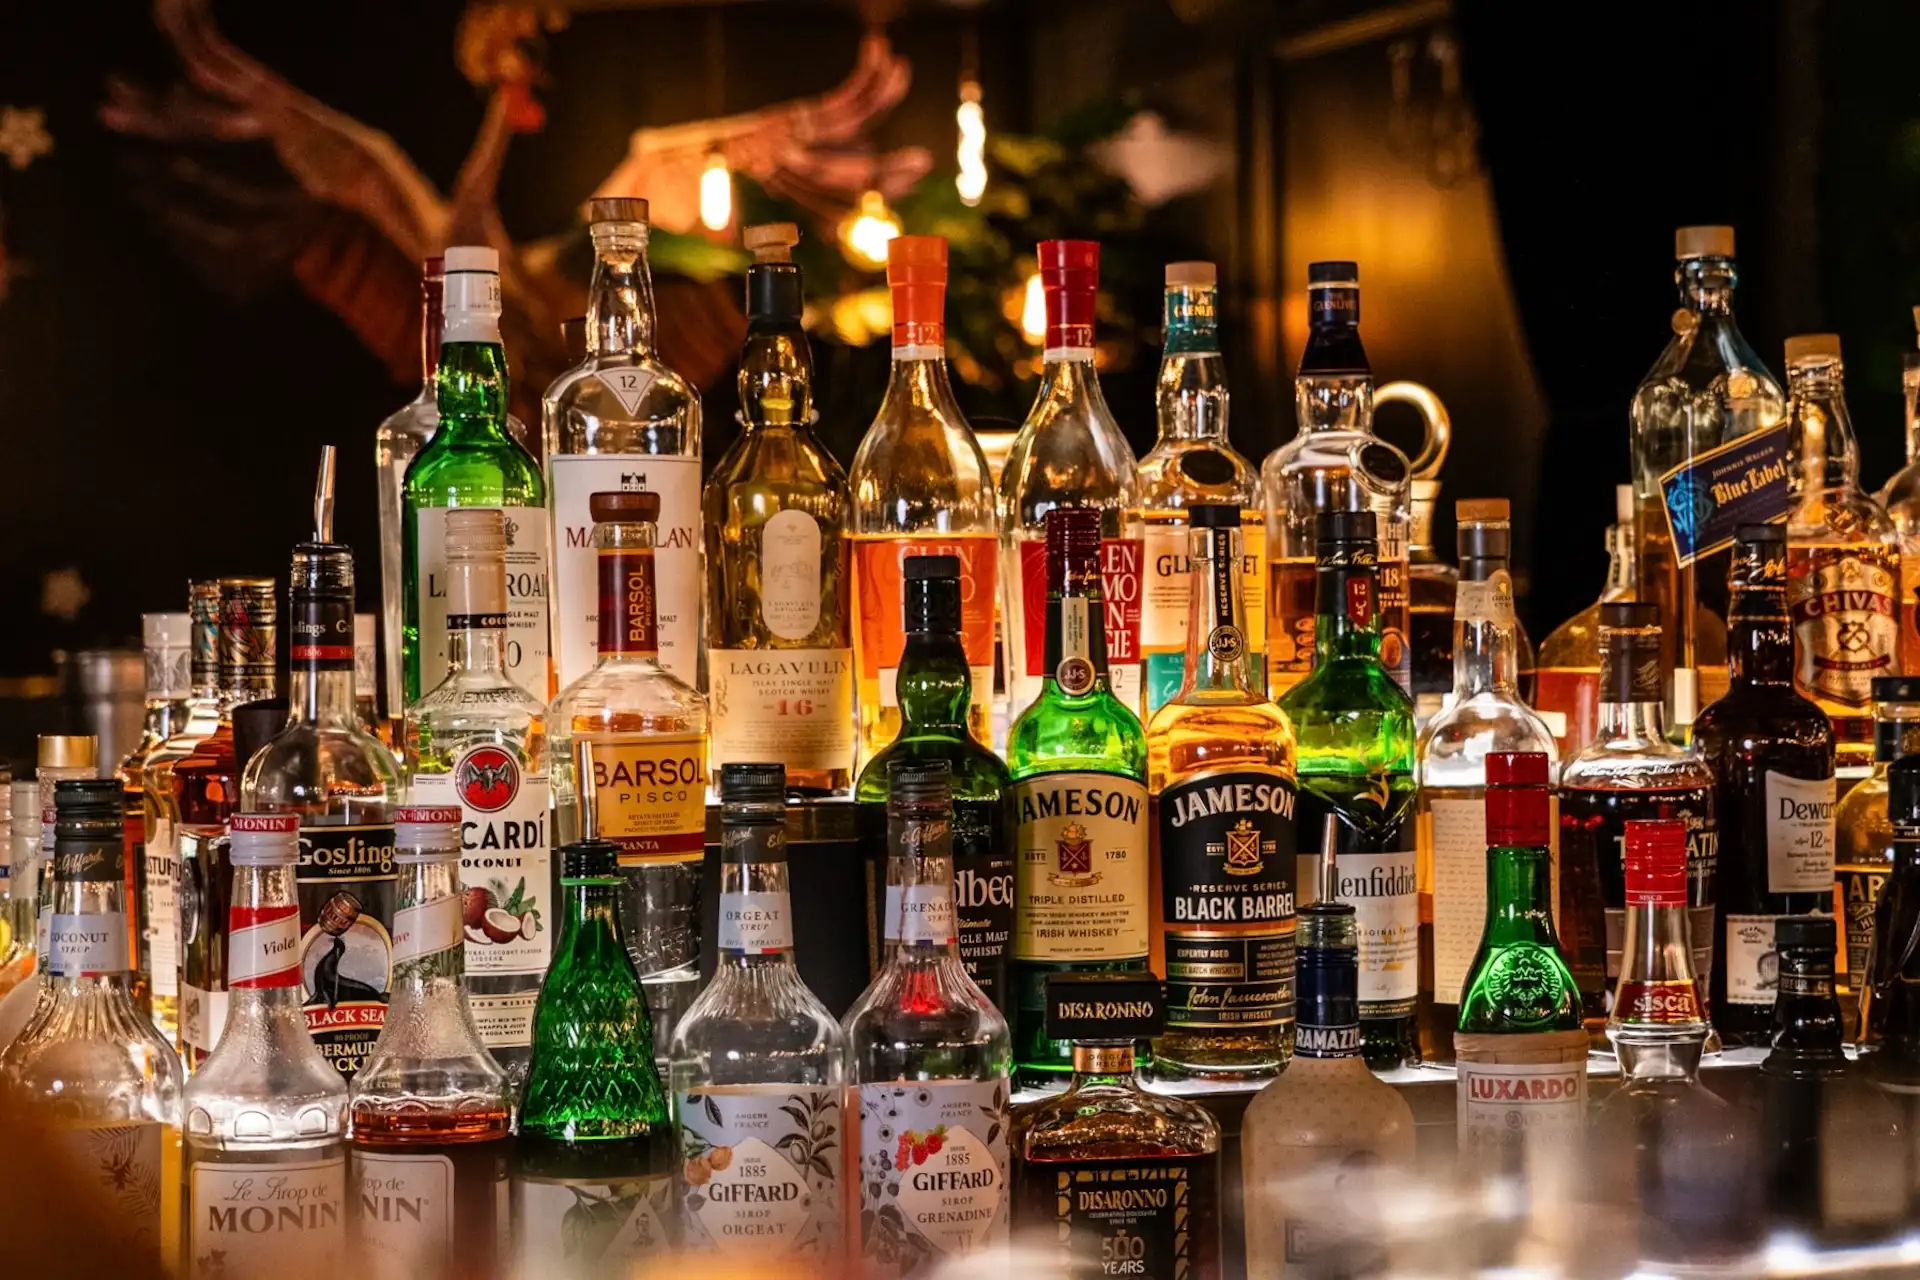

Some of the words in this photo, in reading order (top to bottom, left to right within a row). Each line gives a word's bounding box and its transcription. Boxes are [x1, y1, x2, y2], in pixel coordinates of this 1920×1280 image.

[917, 326, 934, 343] 12
[1077, 329, 1092, 346] 12
[619, 375, 637, 389] 12
[1710, 479, 1748, 508] Blue
[1745, 458, 1785, 492] Label
[1353, 583, 1366, 595] 12
[628, 563, 645, 642] BARSOL
[1804, 590, 1892, 616] CHIVAS
[776, 699, 814, 717] 16
[593, 757, 704, 788] BARSOL
[620, 790, 687, 804] PISCO
[1171, 783, 1295, 828] JAMESON
[233, 817, 287, 831] MONIN
[460, 811, 546, 850] CARDÍ
[1810, 830, 1824, 849] 12
[461, 857, 523, 869] OCONUT
[1105, 851, 1127, 860] 1780
[328, 867, 351, 876] Since
[1192, 884, 1248, 893] RESERVE
[1029, 894, 1065, 905] TRIPLE
[1068, 893, 1125, 904] DISTILLED
[1175, 896, 1237, 921] BLACK
[1242, 891, 1295, 920] BARREL
[726, 910, 780, 921] ORGEAT
[740, 923, 769, 931] SYRUP
[1036, 929, 1065, 938] IRISH
[1068, 928, 1120, 937] WHISKEY
[985, 931, 1008, 943] MALT
[961, 944, 1003, 957] WHISKY
[1058, 1001, 1154, 1021] DISARONNO
[1633, 993, 1691, 1013] sisca
[304, 1009, 356, 1028] BLACK
[360, 1008, 385, 1023] SEA
[1471, 1077, 1577, 1100] LUXARDO
[946, 1153, 971, 1166] 1885
[739, 1165, 767, 1178] 1885
[913, 1168, 994, 1191] GIFFARD
[224, 1177, 253, 1201] Le
[257, 1176, 308, 1203] Sirop
[312, 1183, 328, 1199] de
[385, 1175, 405, 1191] de
[708, 1182, 799, 1202] GIFFARD
[1079, 1188, 1168, 1210] DISARONNO
[942, 1196, 974, 1206] SIROP
[208, 1202, 340, 1234] MONIN
[736, 1210, 772, 1218] SIROP
[917, 1207, 992, 1224] GRENADINE
[722, 1223, 786, 1236] ORGEAT
[1102, 1260, 1145, 1275] YEARS
